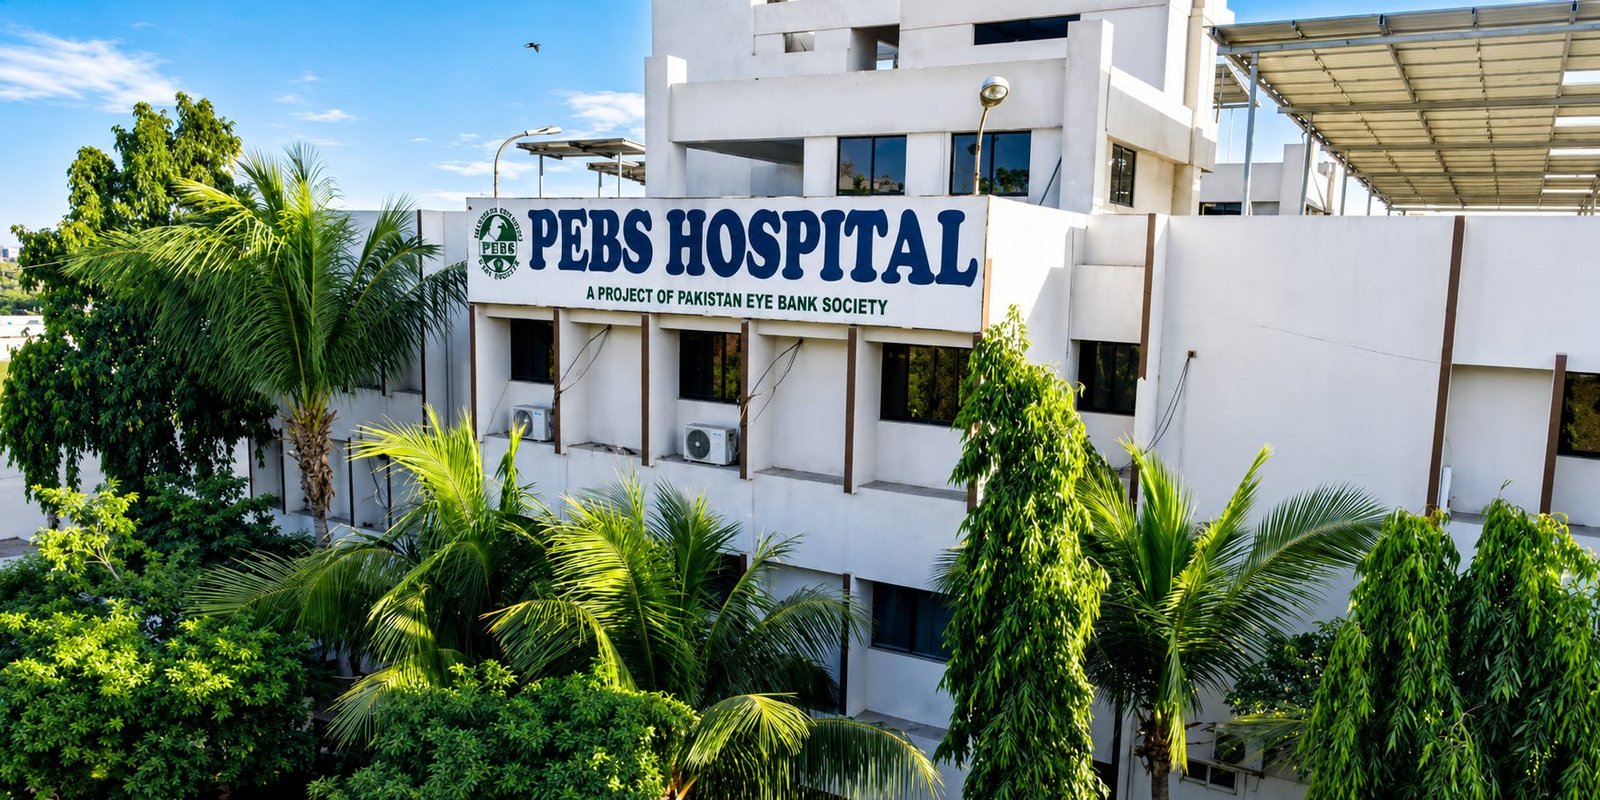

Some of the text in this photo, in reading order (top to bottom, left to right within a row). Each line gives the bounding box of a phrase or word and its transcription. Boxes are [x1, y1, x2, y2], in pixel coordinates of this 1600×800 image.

[481, 241, 515, 254] PEBS
[528, 209, 653, 274] PEBS
[666, 209, 978, 287] HOSPITAL
[586, 286, 888, 315] A PROJECT OF PAKISTAN EYE BANK SOCIETY
